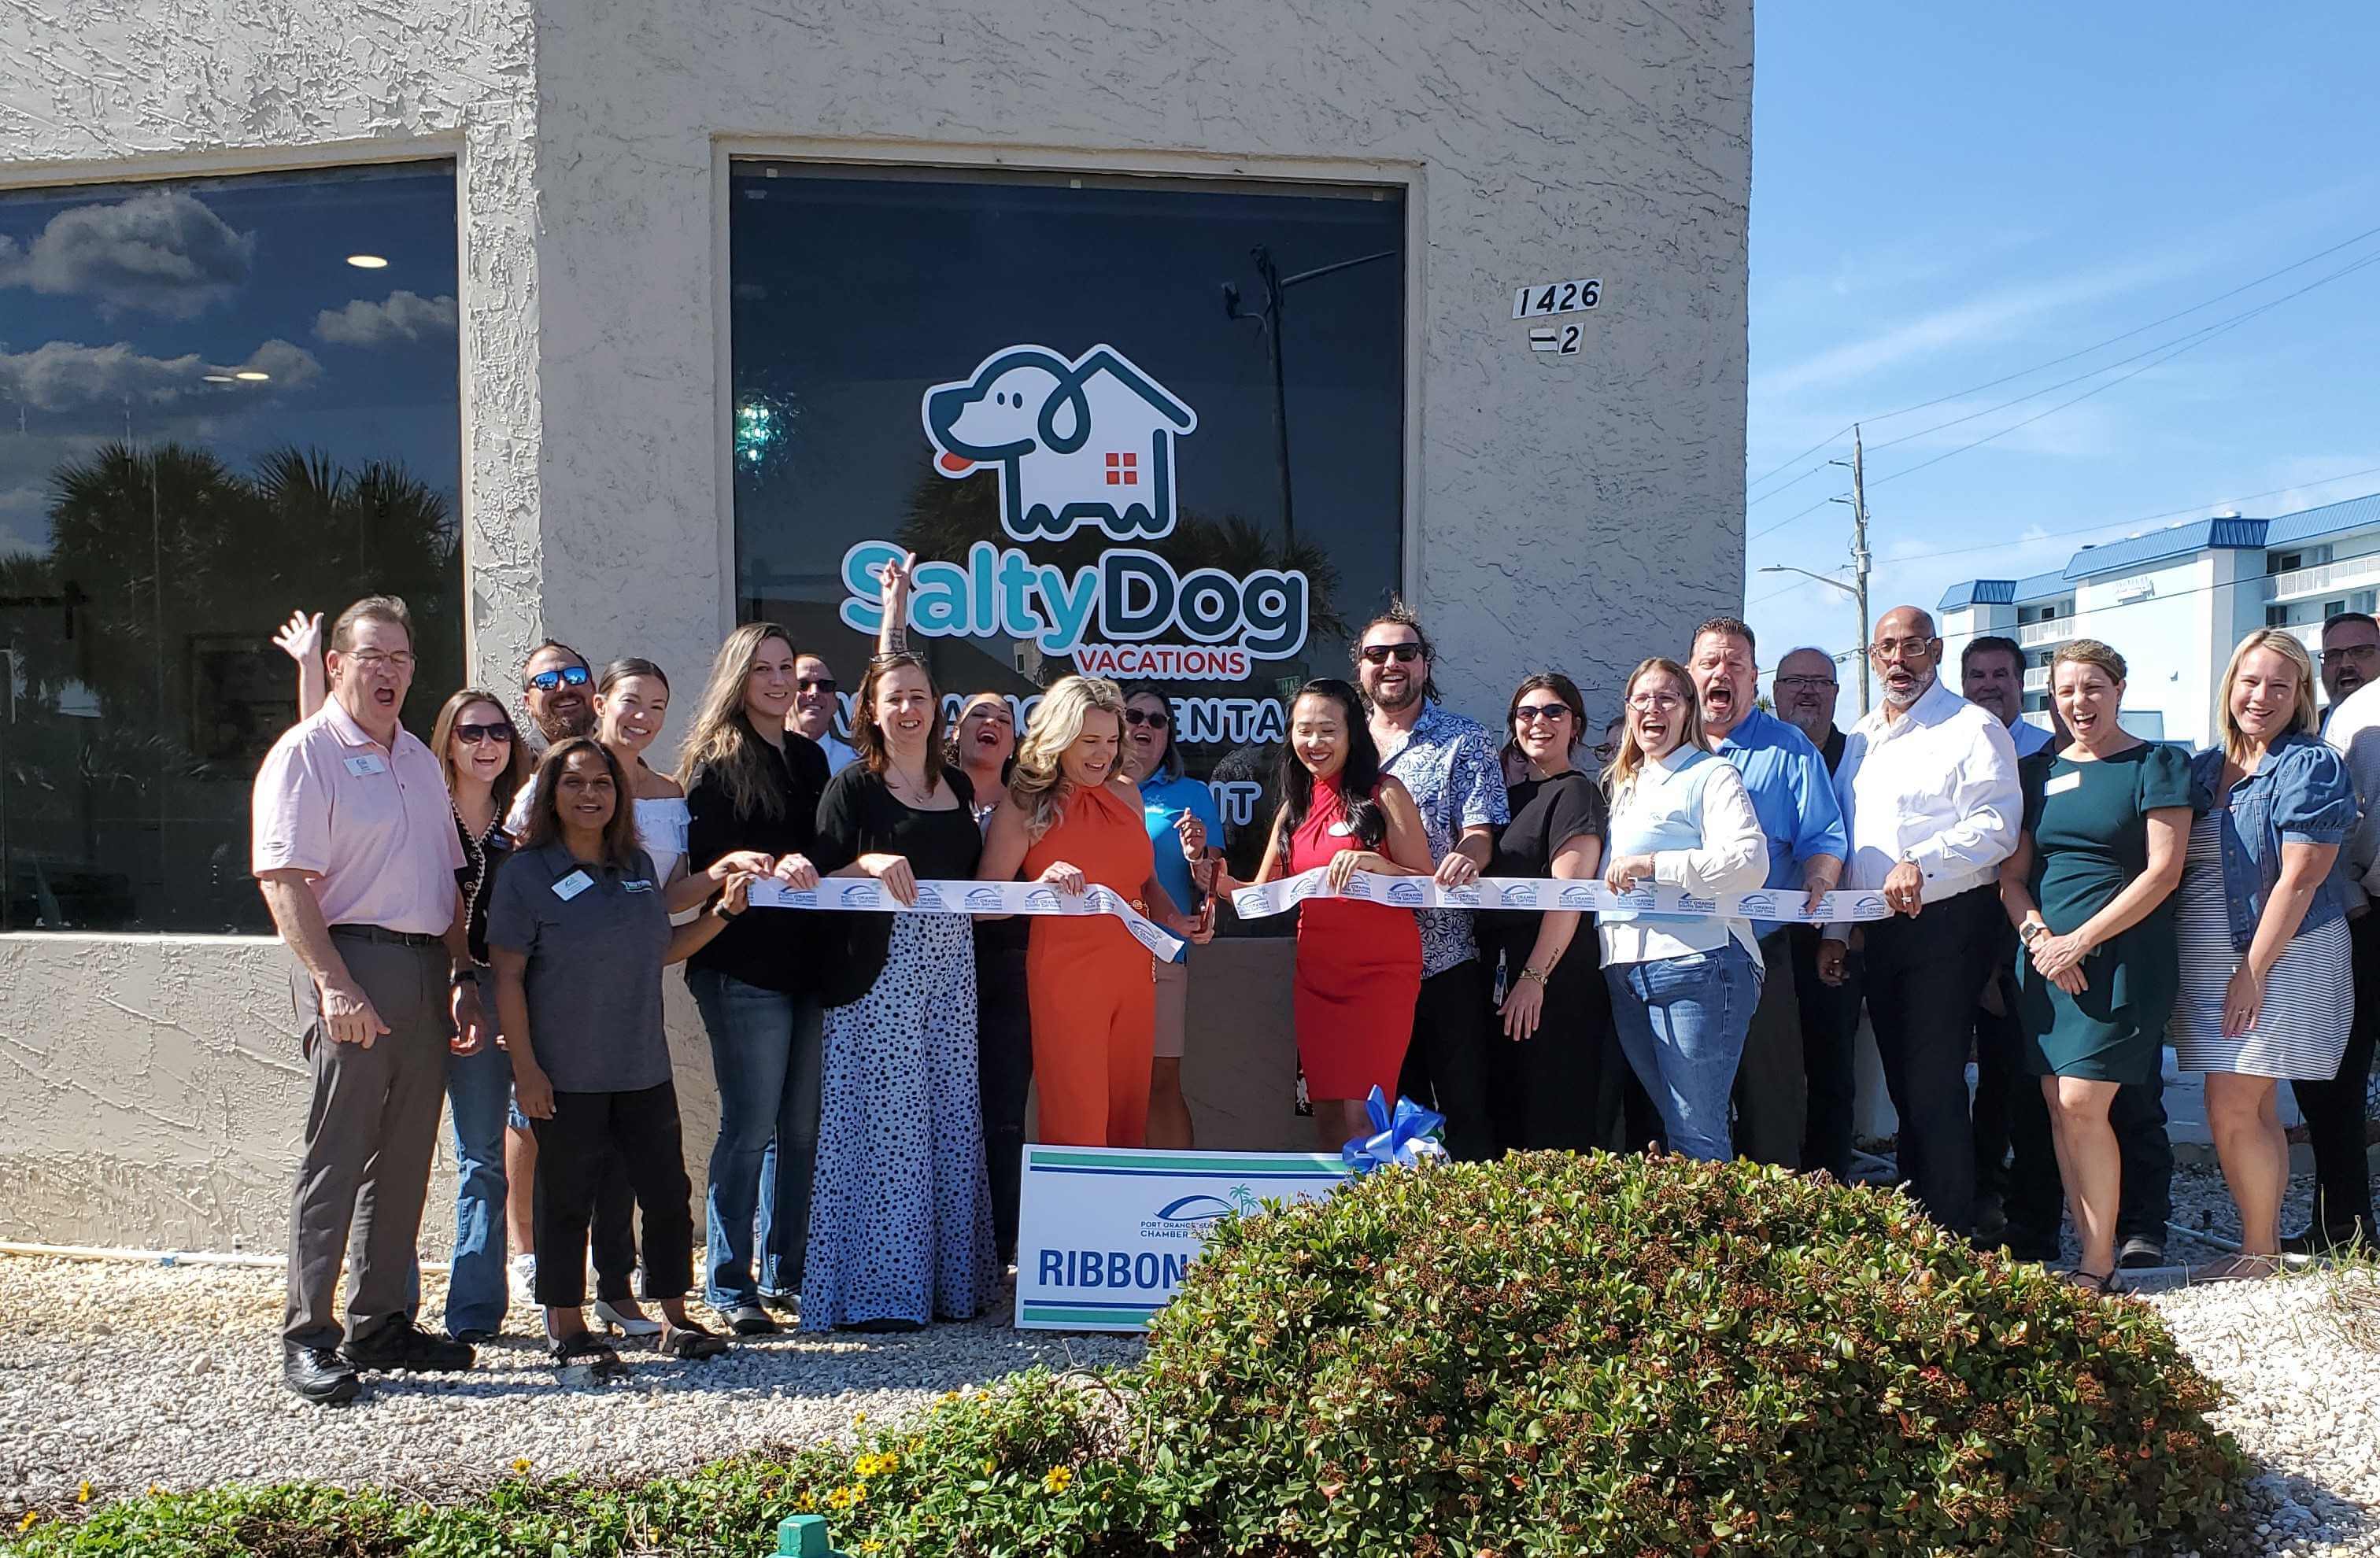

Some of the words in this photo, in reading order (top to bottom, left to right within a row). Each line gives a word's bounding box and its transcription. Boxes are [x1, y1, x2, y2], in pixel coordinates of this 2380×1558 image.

[1521, 280, 1600, 316] 1426
[1077, 649, 1246, 674] VACATIONS
[1039, 1249, 1188, 1289] RIBBON
